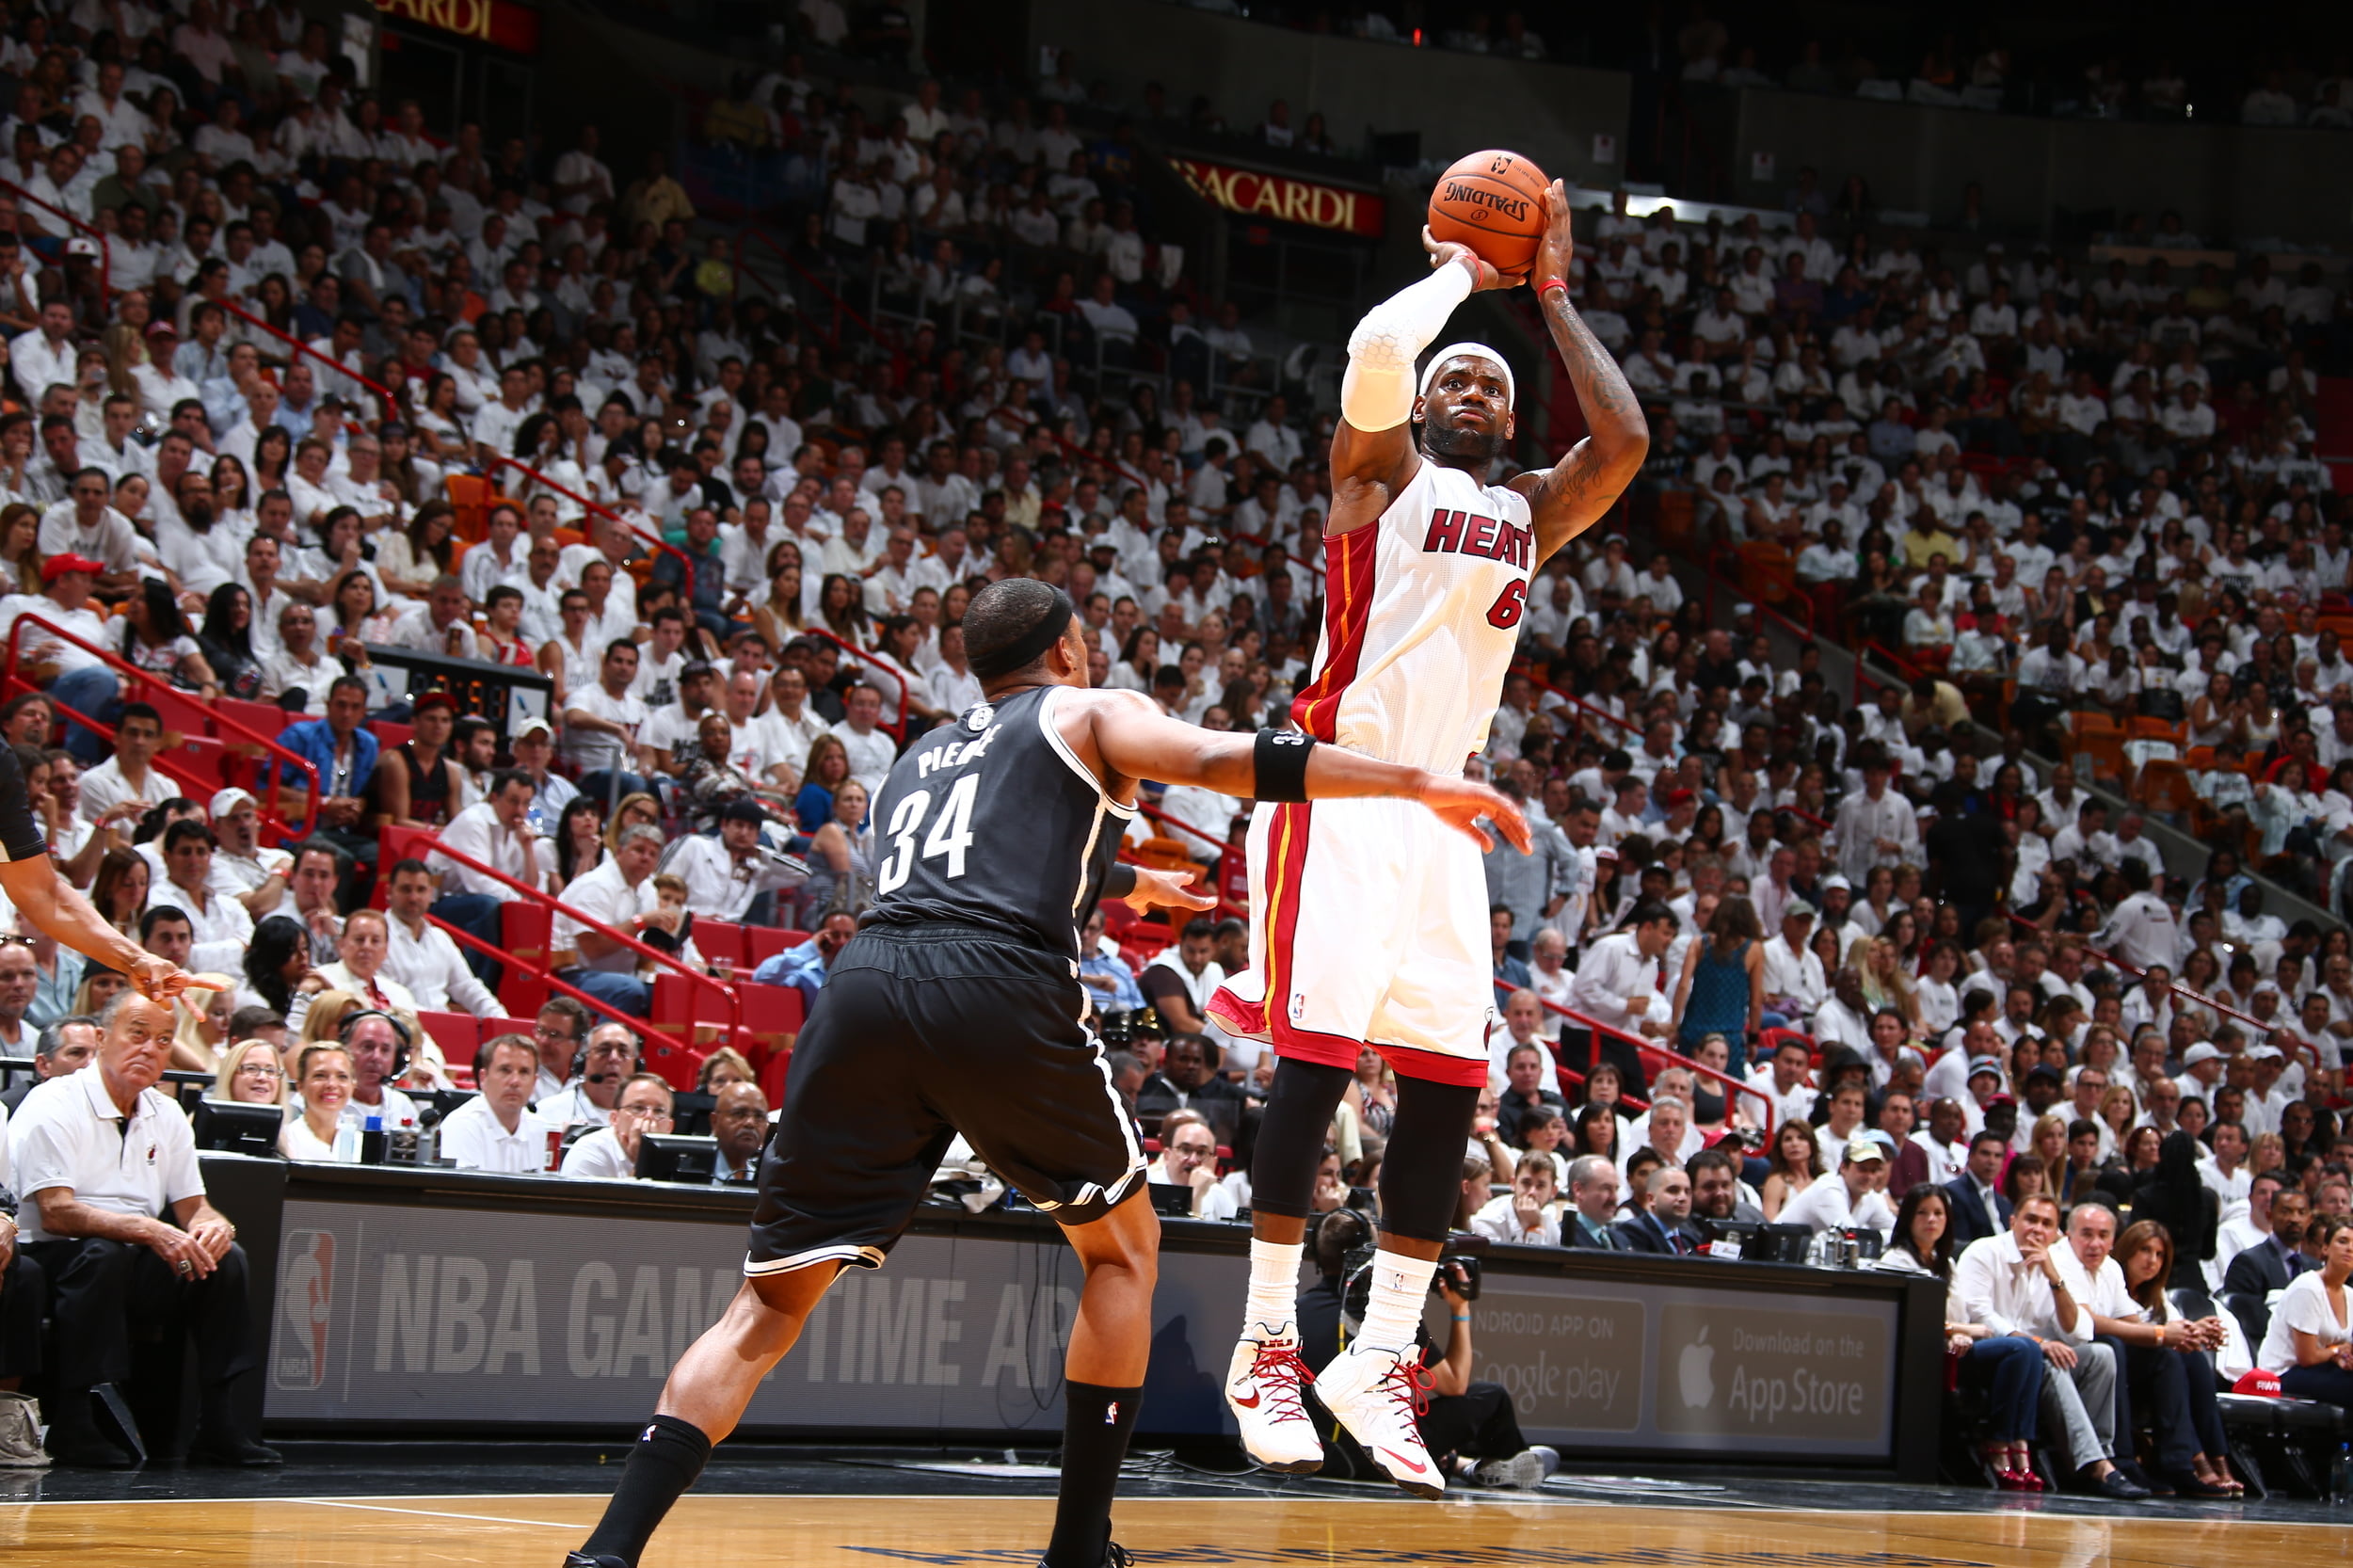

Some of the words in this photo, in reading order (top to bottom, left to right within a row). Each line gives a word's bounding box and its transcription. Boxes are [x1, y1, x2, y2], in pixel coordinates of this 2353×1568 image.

[374, 0, 493, 40] ARDI
[1444, 182, 1529, 222] SPALDING
[1422, 508, 1533, 570] HEAT
[1486, 578, 1527, 630] 6
[878, 773, 980, 896] 34
[374, 1254, 541, 1375] NBA
[568, 1261, 775, 1380] GAM
[806, 1274, 967, 1386] TIME
[1474, 1309, 1545, 1336] NDROID
[1549, 1314, 1584, 1336] APP
[1588, 1317, 1614, 1339] ON
[1733, 1326, 1811, 1355] Download
[1816, 1337, 1834, 1356] on
[1839, 1334, 1865, 1358] the
[1566, 1356, 1622, 1411] play
[1727, 1365, 1786, 1424] App
[1792, 1367, 1864, 1416] Store
